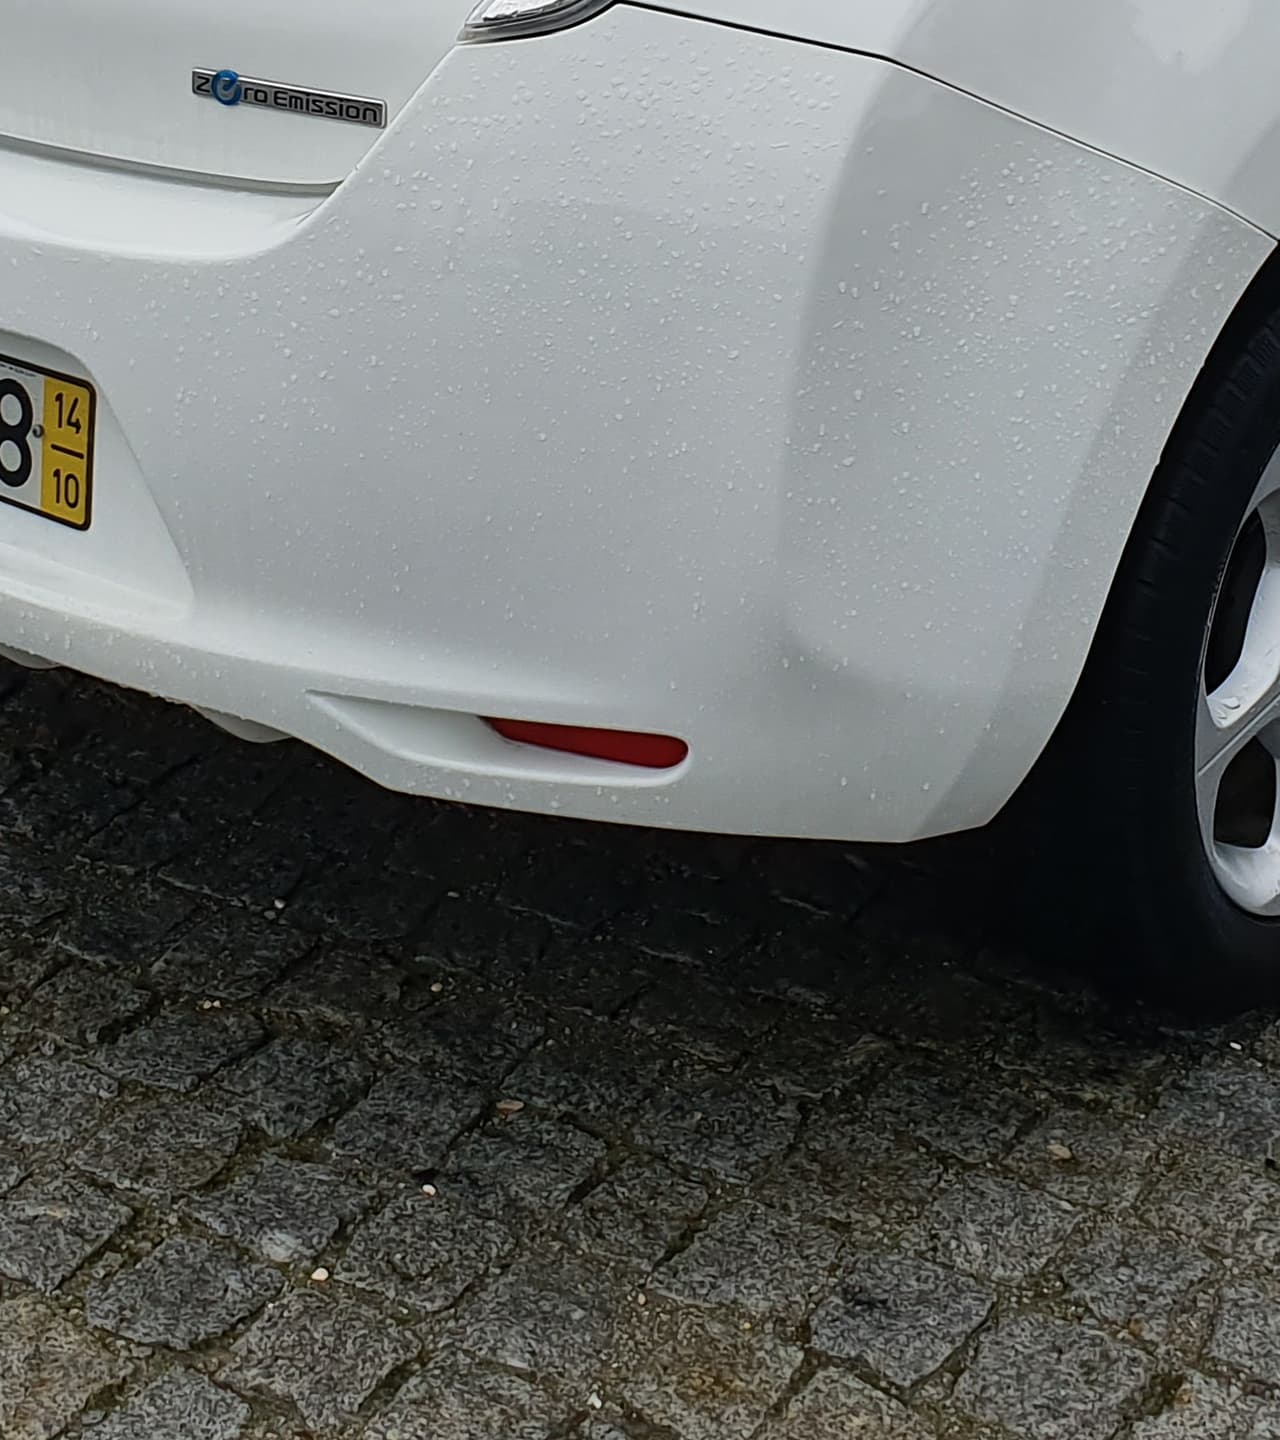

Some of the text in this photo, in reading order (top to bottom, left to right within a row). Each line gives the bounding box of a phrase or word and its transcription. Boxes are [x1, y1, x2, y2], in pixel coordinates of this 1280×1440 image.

[273, 89, 378, 122] Emission
[54, 392, 81, 435] 14
[52, 468, 79, 509] 10
